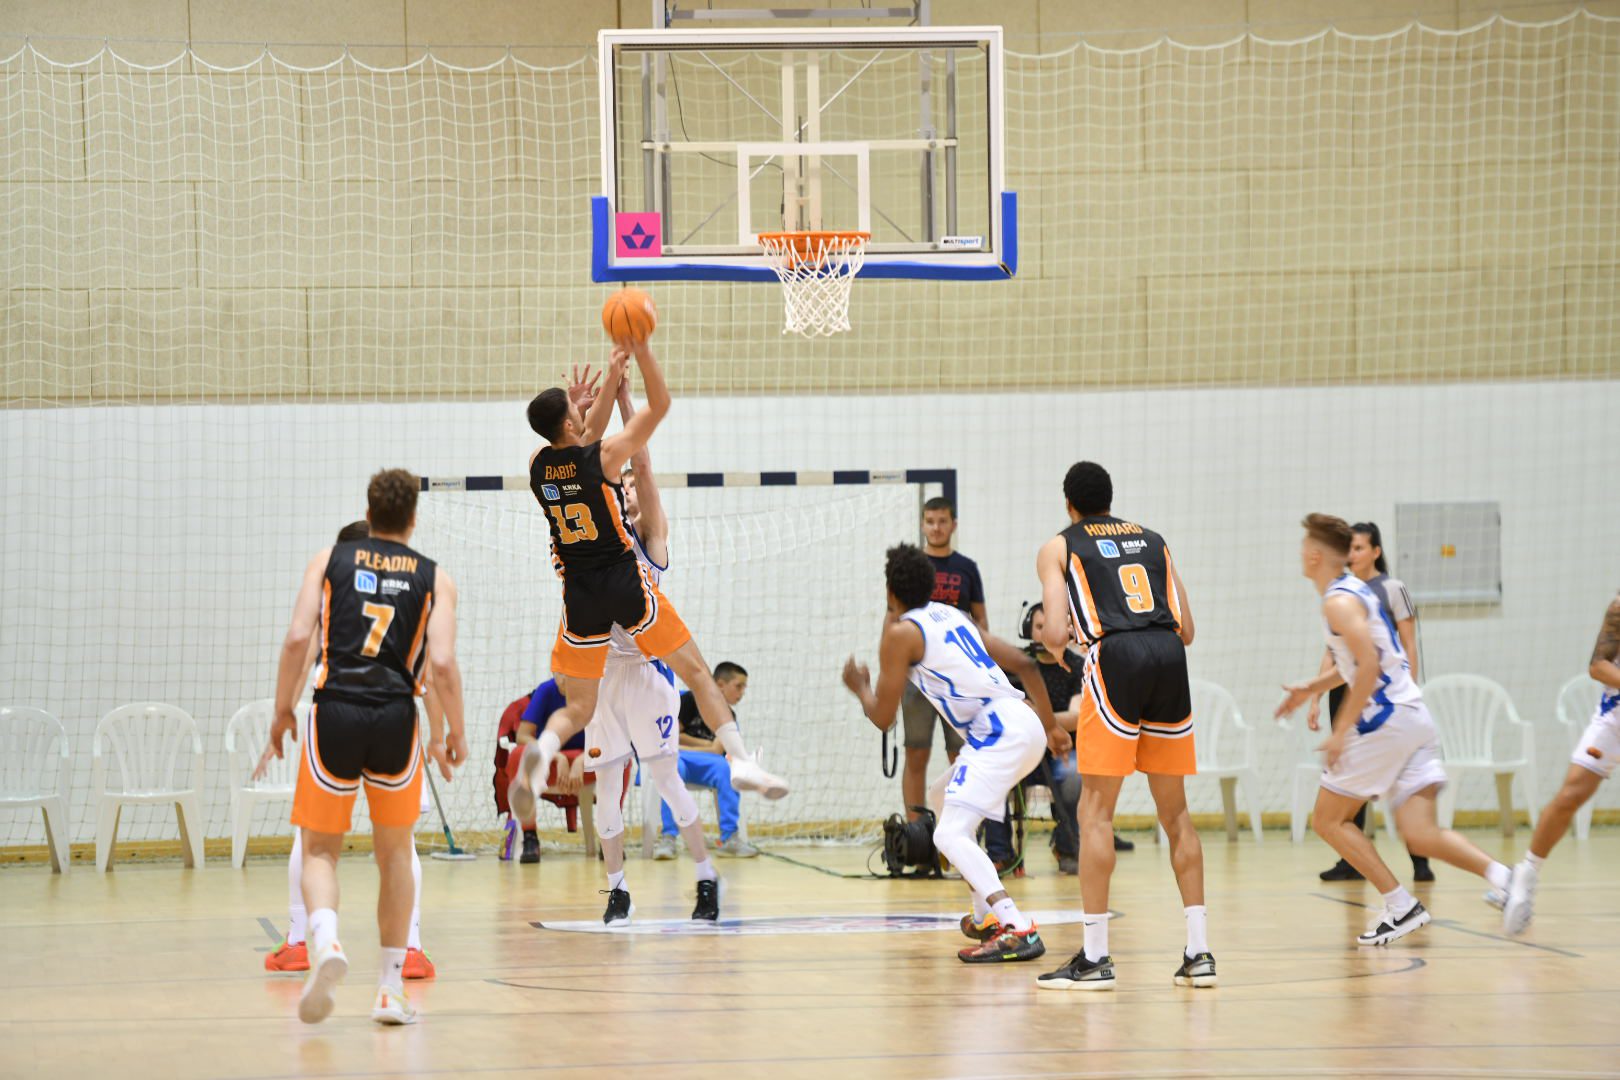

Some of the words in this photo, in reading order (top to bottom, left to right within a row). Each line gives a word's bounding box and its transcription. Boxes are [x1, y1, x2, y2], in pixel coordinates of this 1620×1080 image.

[545, 461, 577, 480] BABIĆ
[548, 502, 599, 545] 13
[1083, 522, 1143, 537] HOWARD
[1121, 539, 1148, 549] KRKA
[354, 549, 418, 574] PLEADIN
[381, 578, 411, 592] KRKA
[1117, 563, 1155, 614] 9
[360, 600, 396, 658] 7
[944, 625, 996, 669] 14
[655, 715, 673, 739] 12
